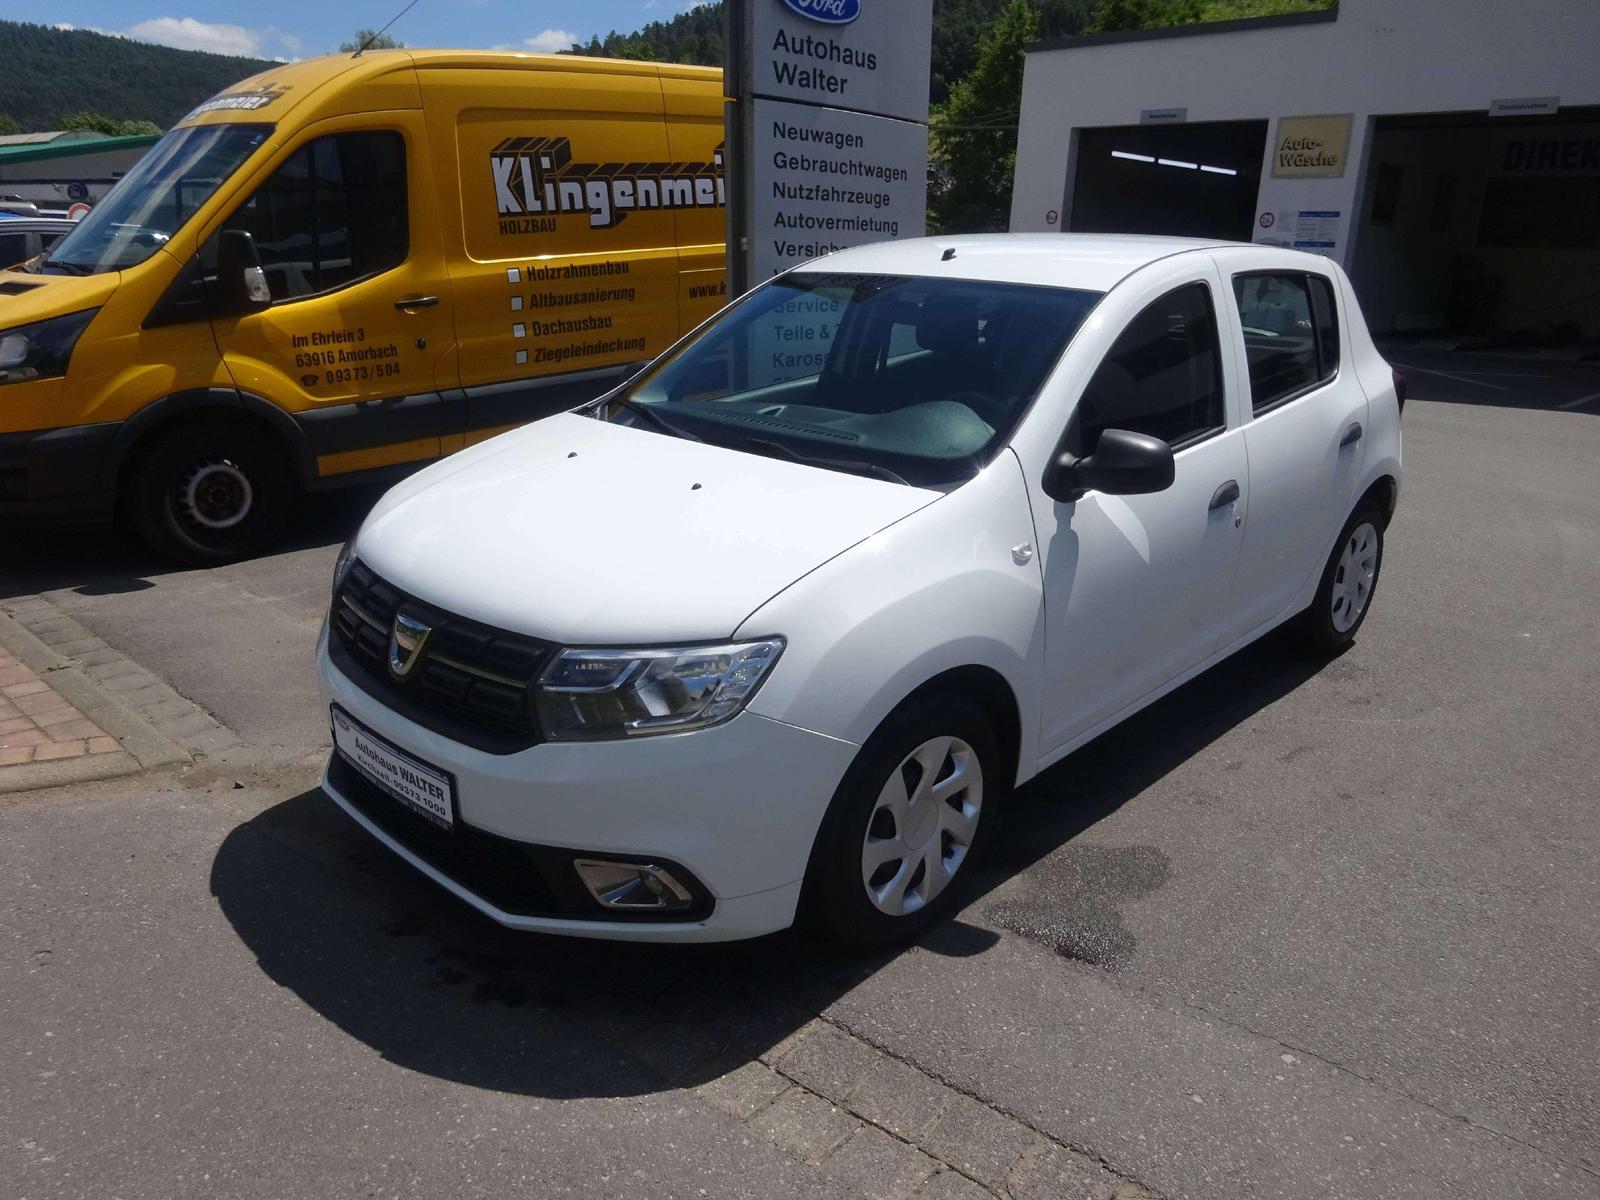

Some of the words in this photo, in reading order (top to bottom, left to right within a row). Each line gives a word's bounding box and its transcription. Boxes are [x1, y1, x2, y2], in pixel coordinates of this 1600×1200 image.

[772, 28, 877, 70] Autohaus
[772, 61, 847, 94] Walter
[773, 121, 864, 148] Neuwagen
[773, 152, 907, 182] Gebrauchtwagen
[773, 182, 890, 209] Nutzfahrzeuge
[499, 218, 557, 235] HOLZBAU
[774, 211, 898, 236] Autovermietung
[527, 261, 629, 282] Holzrahmenbau
[529, 286, 635, 309] Altbausanierung
[292, 334, 308, 348] Im
[312, 330, 354, 345] Ehrlein
[357, 328, 365, 342] 3
[532, 316, 612, 336] Dachausbau
[774, 325, 815, 341] Teile
[820, 324, 830, 340] &
[296, 351, 335, 368] 63916
[338, 344, 399, 363] Amorbach
[534, 336, 646, 363] Ziegeleindeckung
[355, 737, 398, 776] Autohaus
[399, 765, 445, 802] WALTER
[422, 798, 446, 815] 1000
